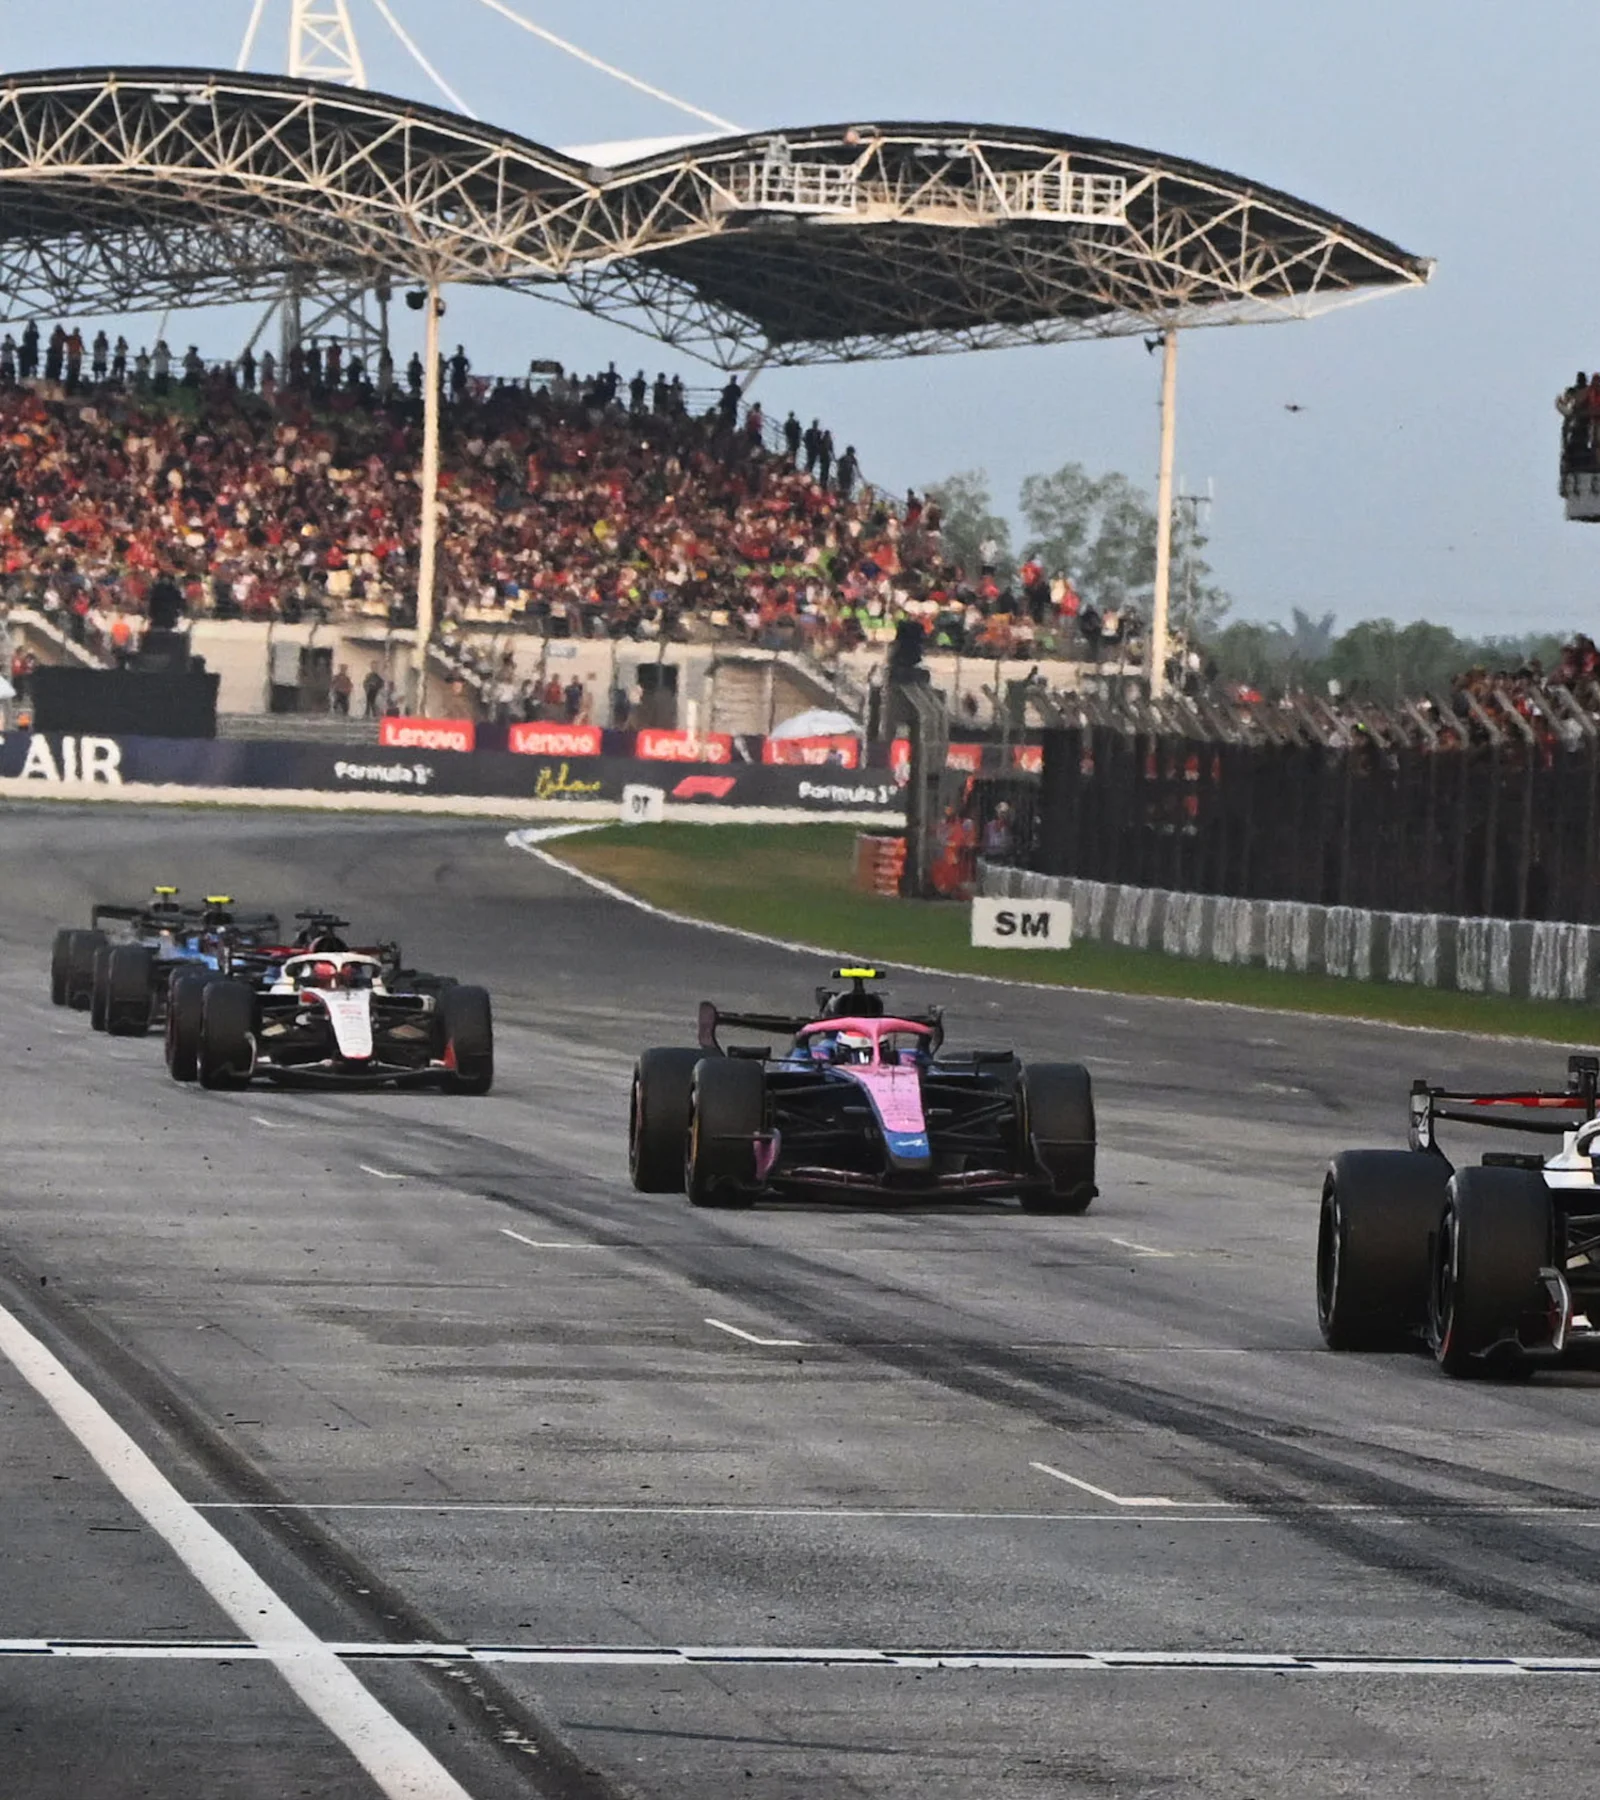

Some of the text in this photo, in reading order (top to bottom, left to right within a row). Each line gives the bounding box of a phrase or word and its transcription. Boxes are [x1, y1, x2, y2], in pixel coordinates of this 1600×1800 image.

[385, 723, 466, 752] Lenovo
[514, 728, 594, 755] Lenovo
[643, 735, 724, 762] Lenoo
[20, 733, 123, 785] AIR
[334, 761, 413, 783] Formula
[799, 781, 876, 803] Formula
[994, 910, 1051, 938] SM
